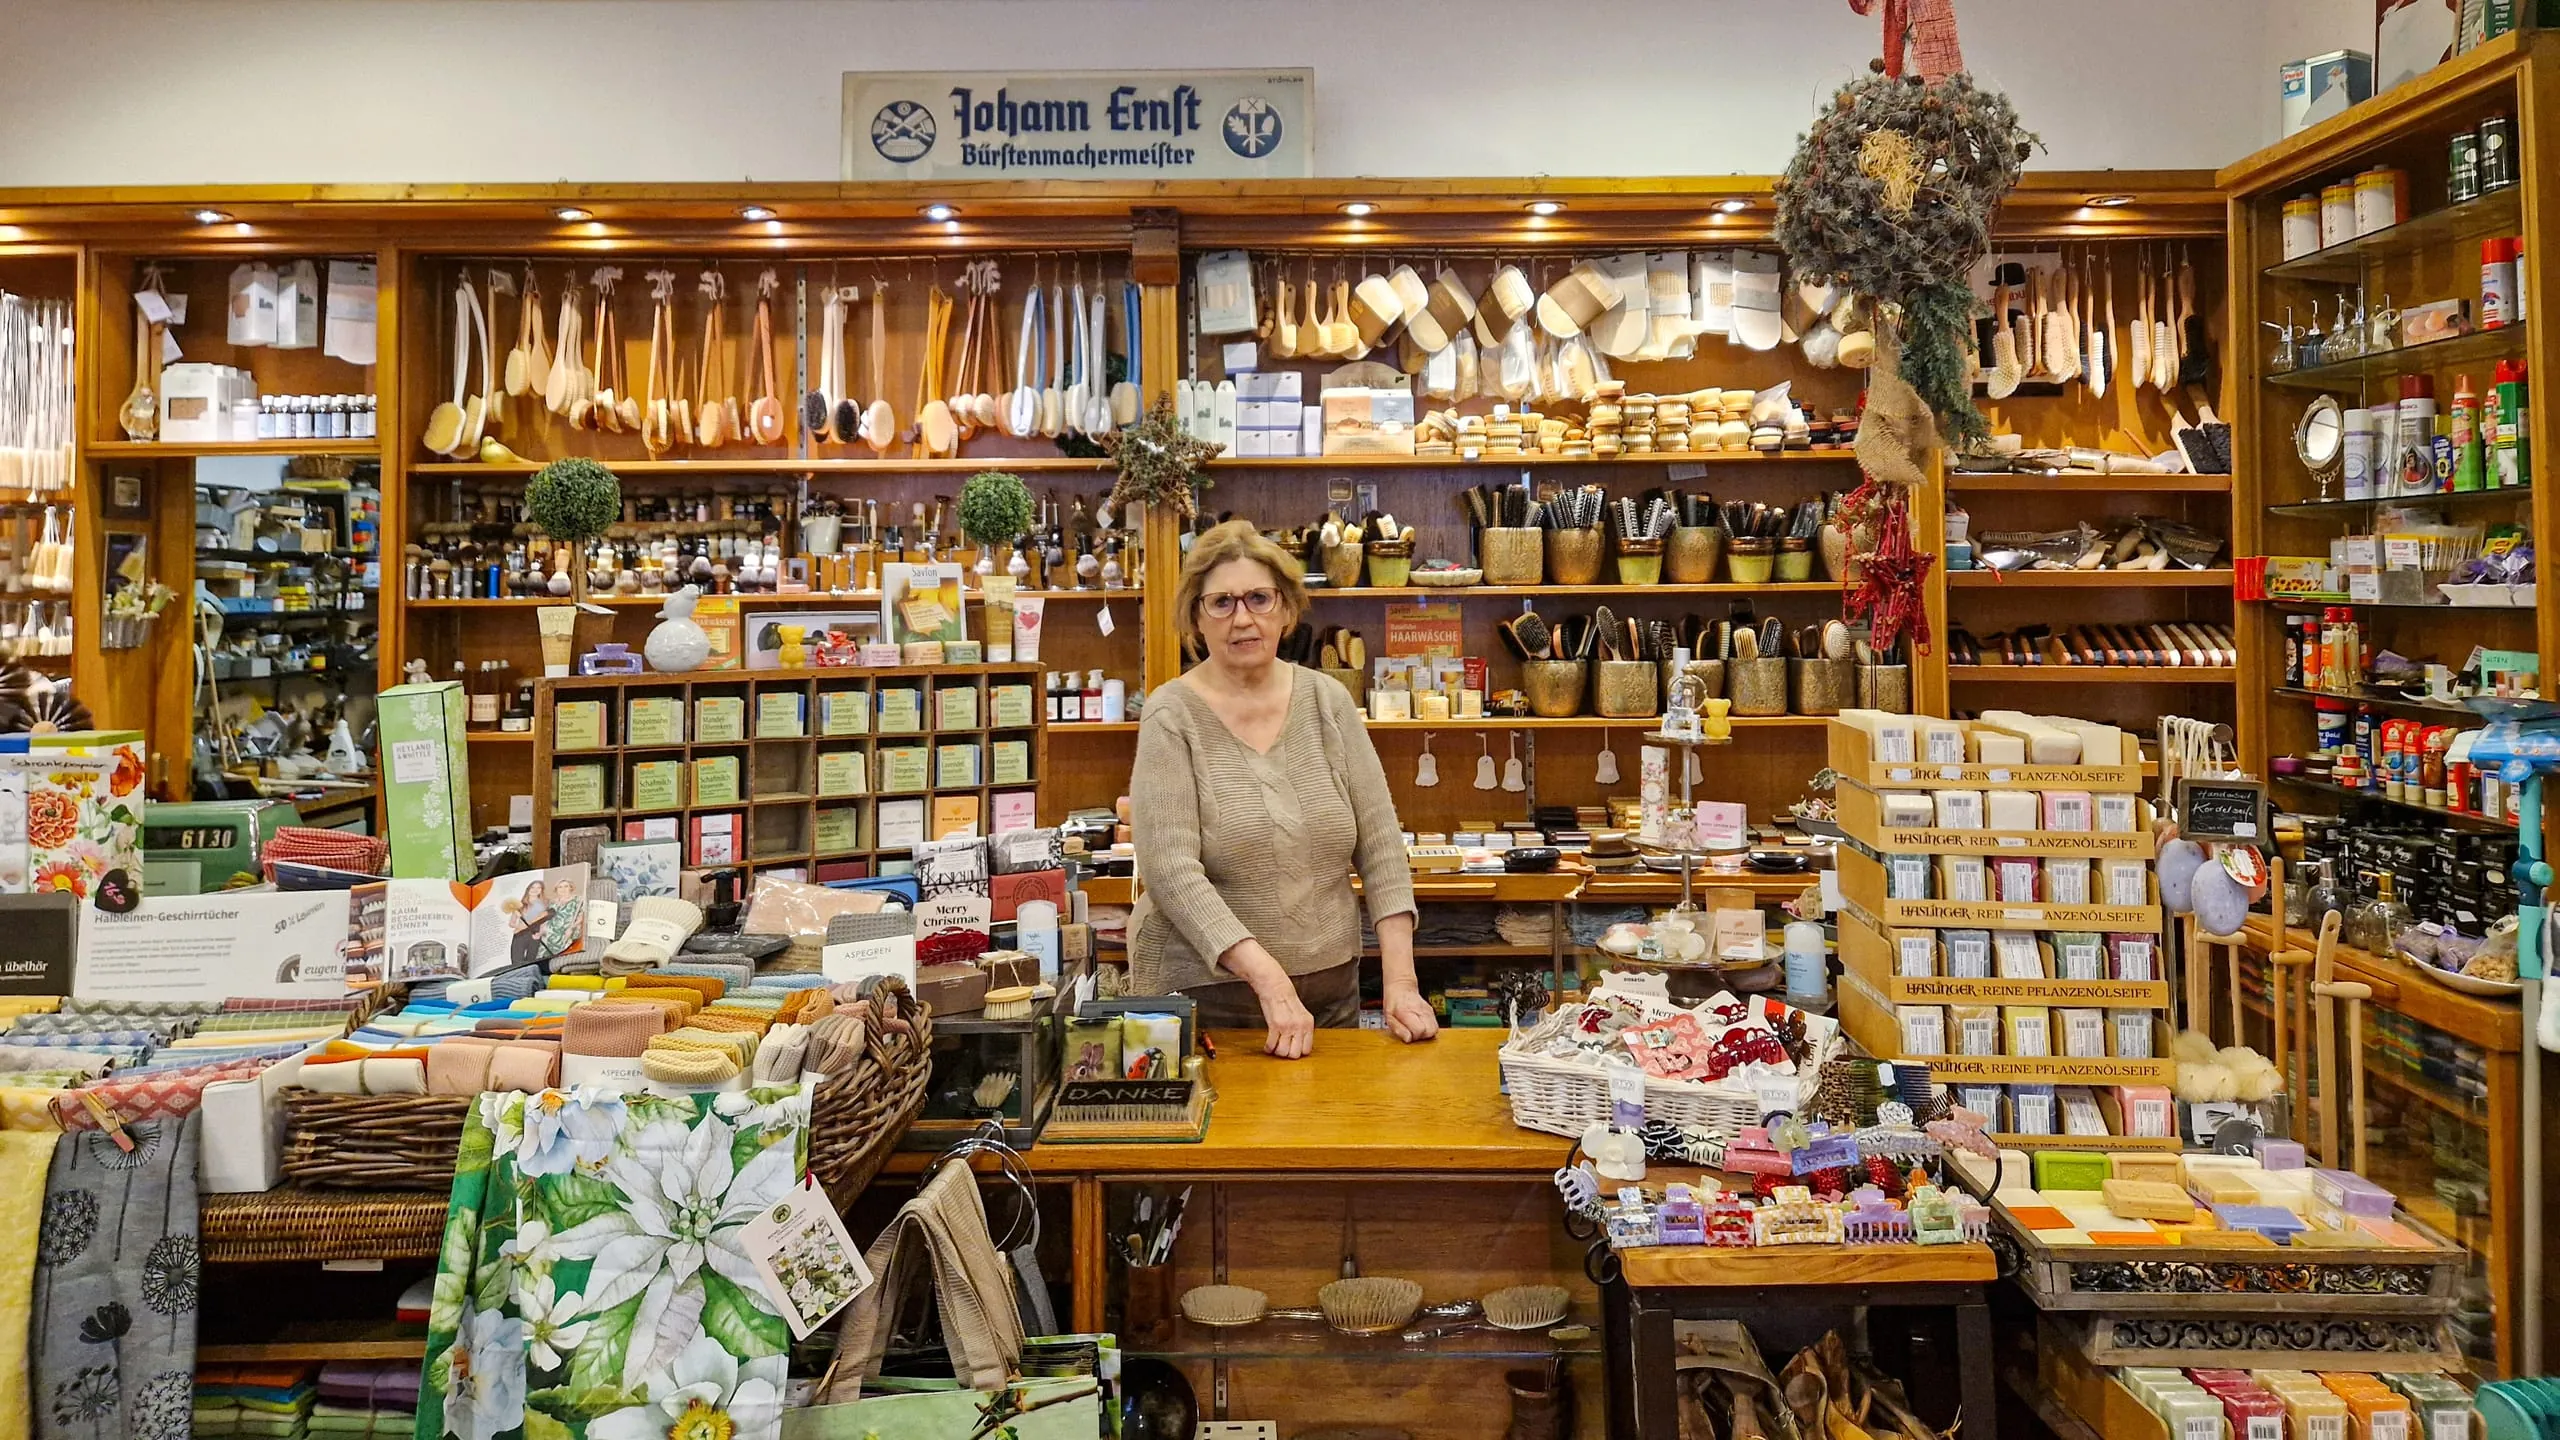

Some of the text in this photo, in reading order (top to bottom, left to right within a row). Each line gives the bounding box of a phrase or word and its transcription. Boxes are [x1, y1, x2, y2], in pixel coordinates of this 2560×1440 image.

[948, 84, 1203, 138] Johann Ernst
[961, 142, 1195, 169] Bürstenmachermeister
[1390, 629, 1457, 642] HAARWÄSCHE
[1885, 767, 1955, 782] HLINGE
[2010, 769, 2125, 783] FLANZENÖLSEIFE
[1894, 830, 2138, 850] HASLINGER REIN FLANZENÖLSEIFE
[94, 908, 240, 924] Halbleinen-Geschirrtücher
[936, 904, 969, 915] Merry
[1901, 903, 2145, 923] HASLINGER REIN ANZENÖLSEIFE
[273, 919, 287, 934] 50
[923, 915, 980, 927] Christmas
[843, 945, 892, 960] ASPEGREN
[5, 961, 48, 975] übelhör
[304, 964, 338, 977] eugen
[1906, 981, 2152, 999] HASLINGER REINE PFLANZENÖLSEIFE
[601, 1068, 643, 1077] ASPEGREN
[1991, 1063, 2032, 1074] REINE
[2036, 1062, 2160, 1077] PFLANZENÖLSEIFE
[1067, 1087, 1185, 1101] DANKE
